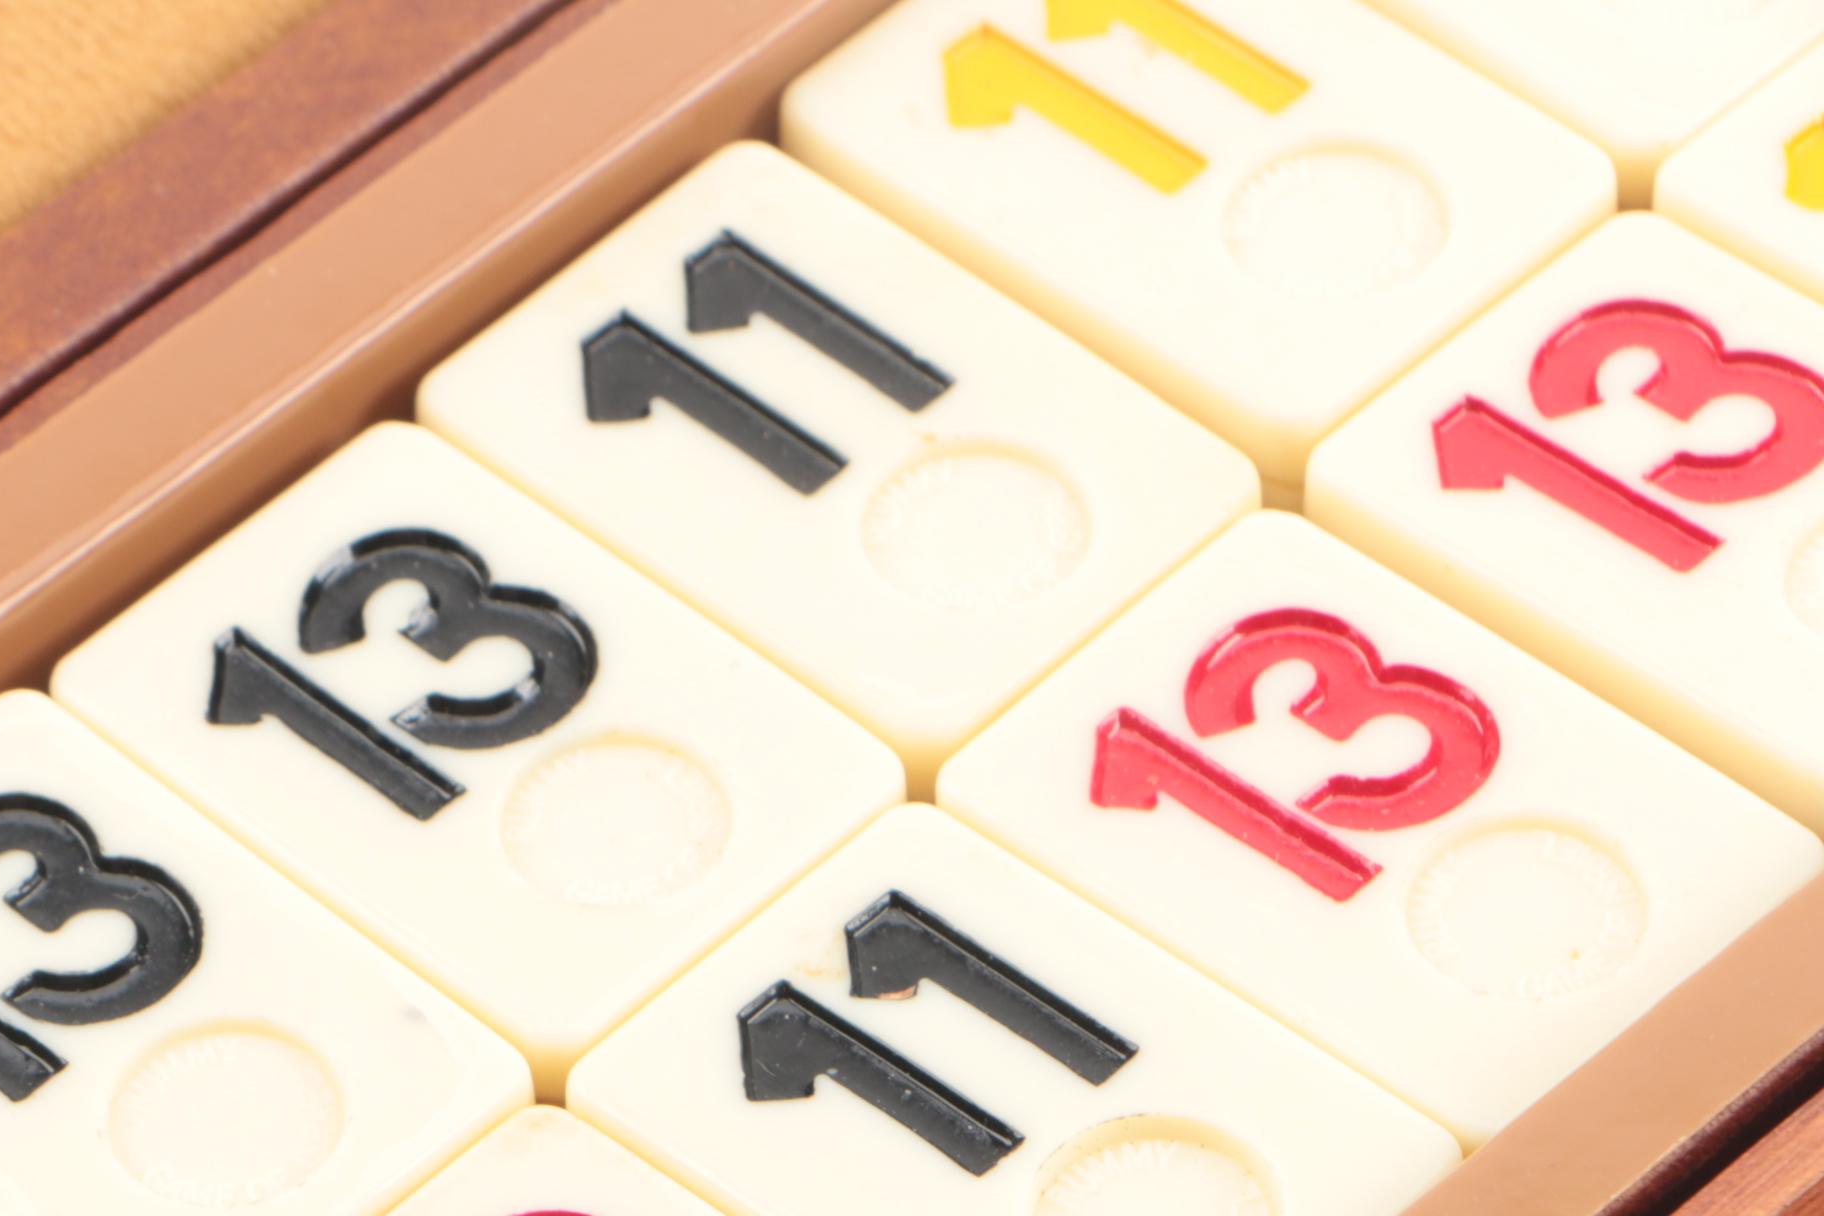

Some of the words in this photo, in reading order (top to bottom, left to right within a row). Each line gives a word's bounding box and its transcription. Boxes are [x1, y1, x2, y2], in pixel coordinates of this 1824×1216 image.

[943, 0, 1310, 194] 11
[580, 231, 953, 494] 11
[1432, 297, 1824, 574] 13
[205, 528, 599, 821] 13
[1089, 606, 1502, 905] 13
[736, 890, 1138, 1176] 11
